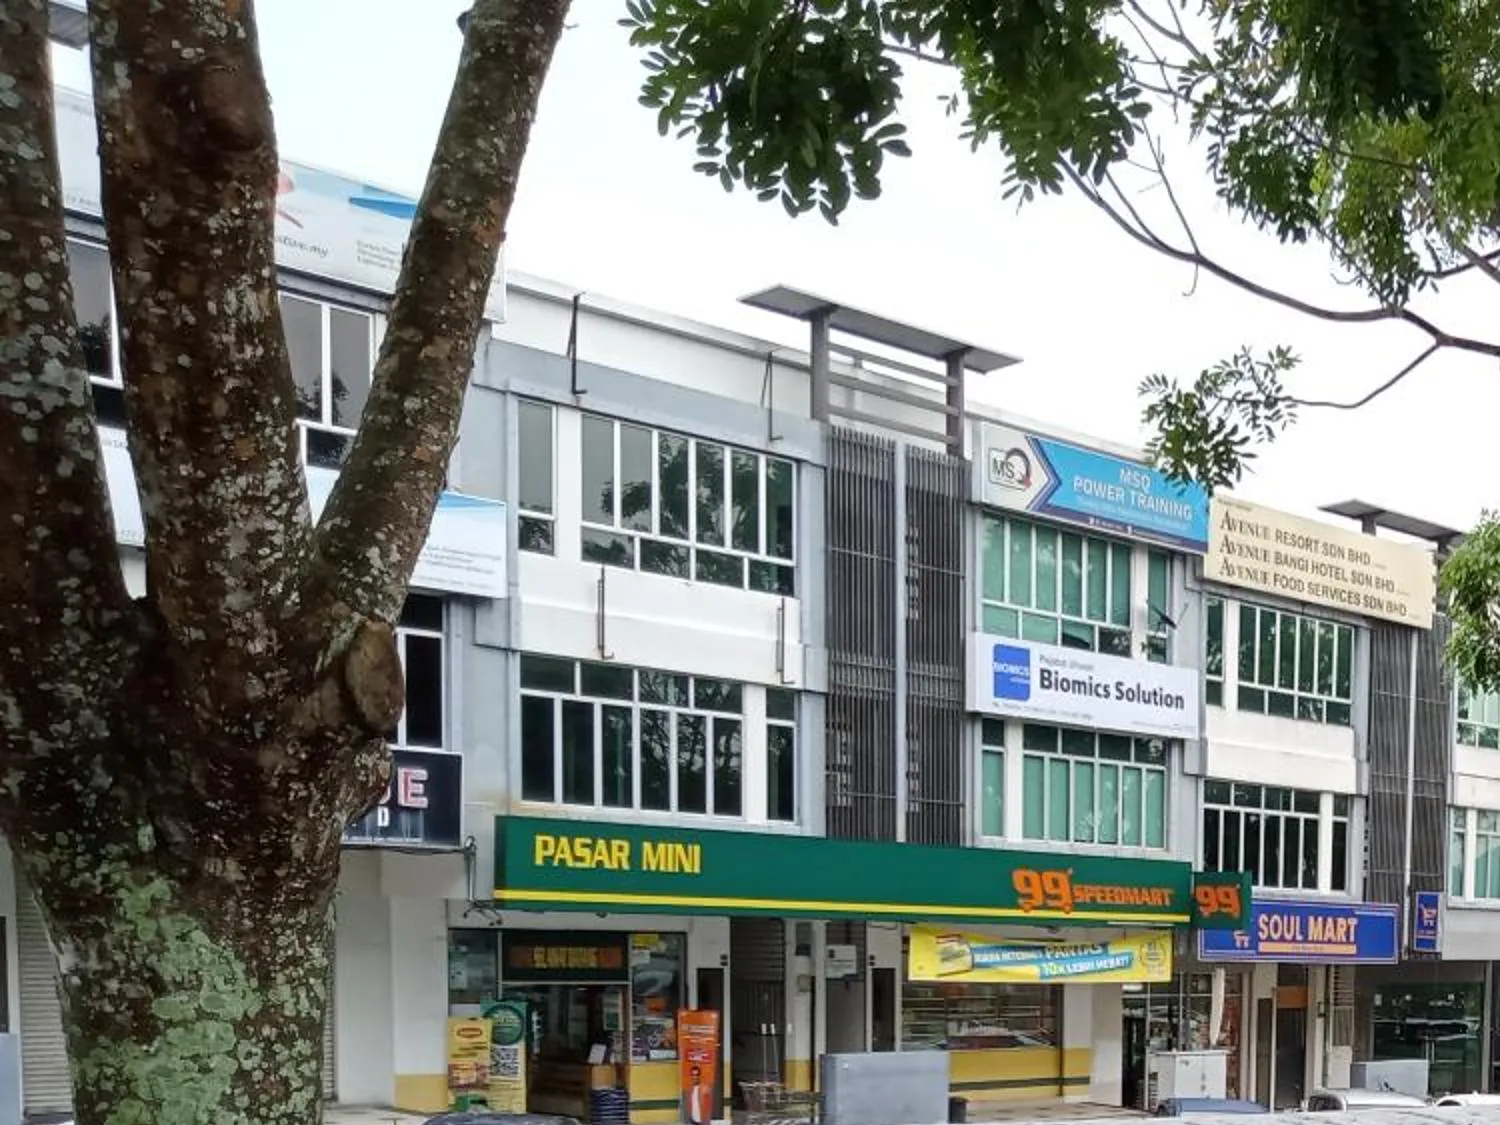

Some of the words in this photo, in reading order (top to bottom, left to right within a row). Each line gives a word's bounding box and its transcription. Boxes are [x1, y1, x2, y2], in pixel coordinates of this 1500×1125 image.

[1072, 476, 1125, 504] POWER
[1128, 489, 1194, 521] TRAINING
[1119, 468, 1151, 491] MSQ
[1275, 531, 1320, 553] RESORT
[1321, 542, 1346, 560] SDN
[1347, 549, 1371, 566] BHD
[1274, 551, 1309, 573] BANGI
[1311, 559, 1348, 582] HOTEL
[1350, 570, 1373, 589] SDN
[1374, 578, 1395, 595] BHD
[1273, 573, 1305, 593] FOOD
[1307, 582, 1361, 607] SERVICES
[1363, 595, 1384, 611] SDN
[1385, 601, 1407, 617] BHD
[1039, 667, 1111, 699] Biomics
[1115, 681, 1185, 709] Solution
[534, 834, 631, 871] PASAR
[641, 841, 702, 874] MINI
[1012, 867, 1073, 914] 99
[1072, 884, 1175, 907] SPEEDMART
[1195, 884, 1241, 919] 99
[1258, 914, 1303, 941] SOUL
[1307, 917, 1358, 943] MART
